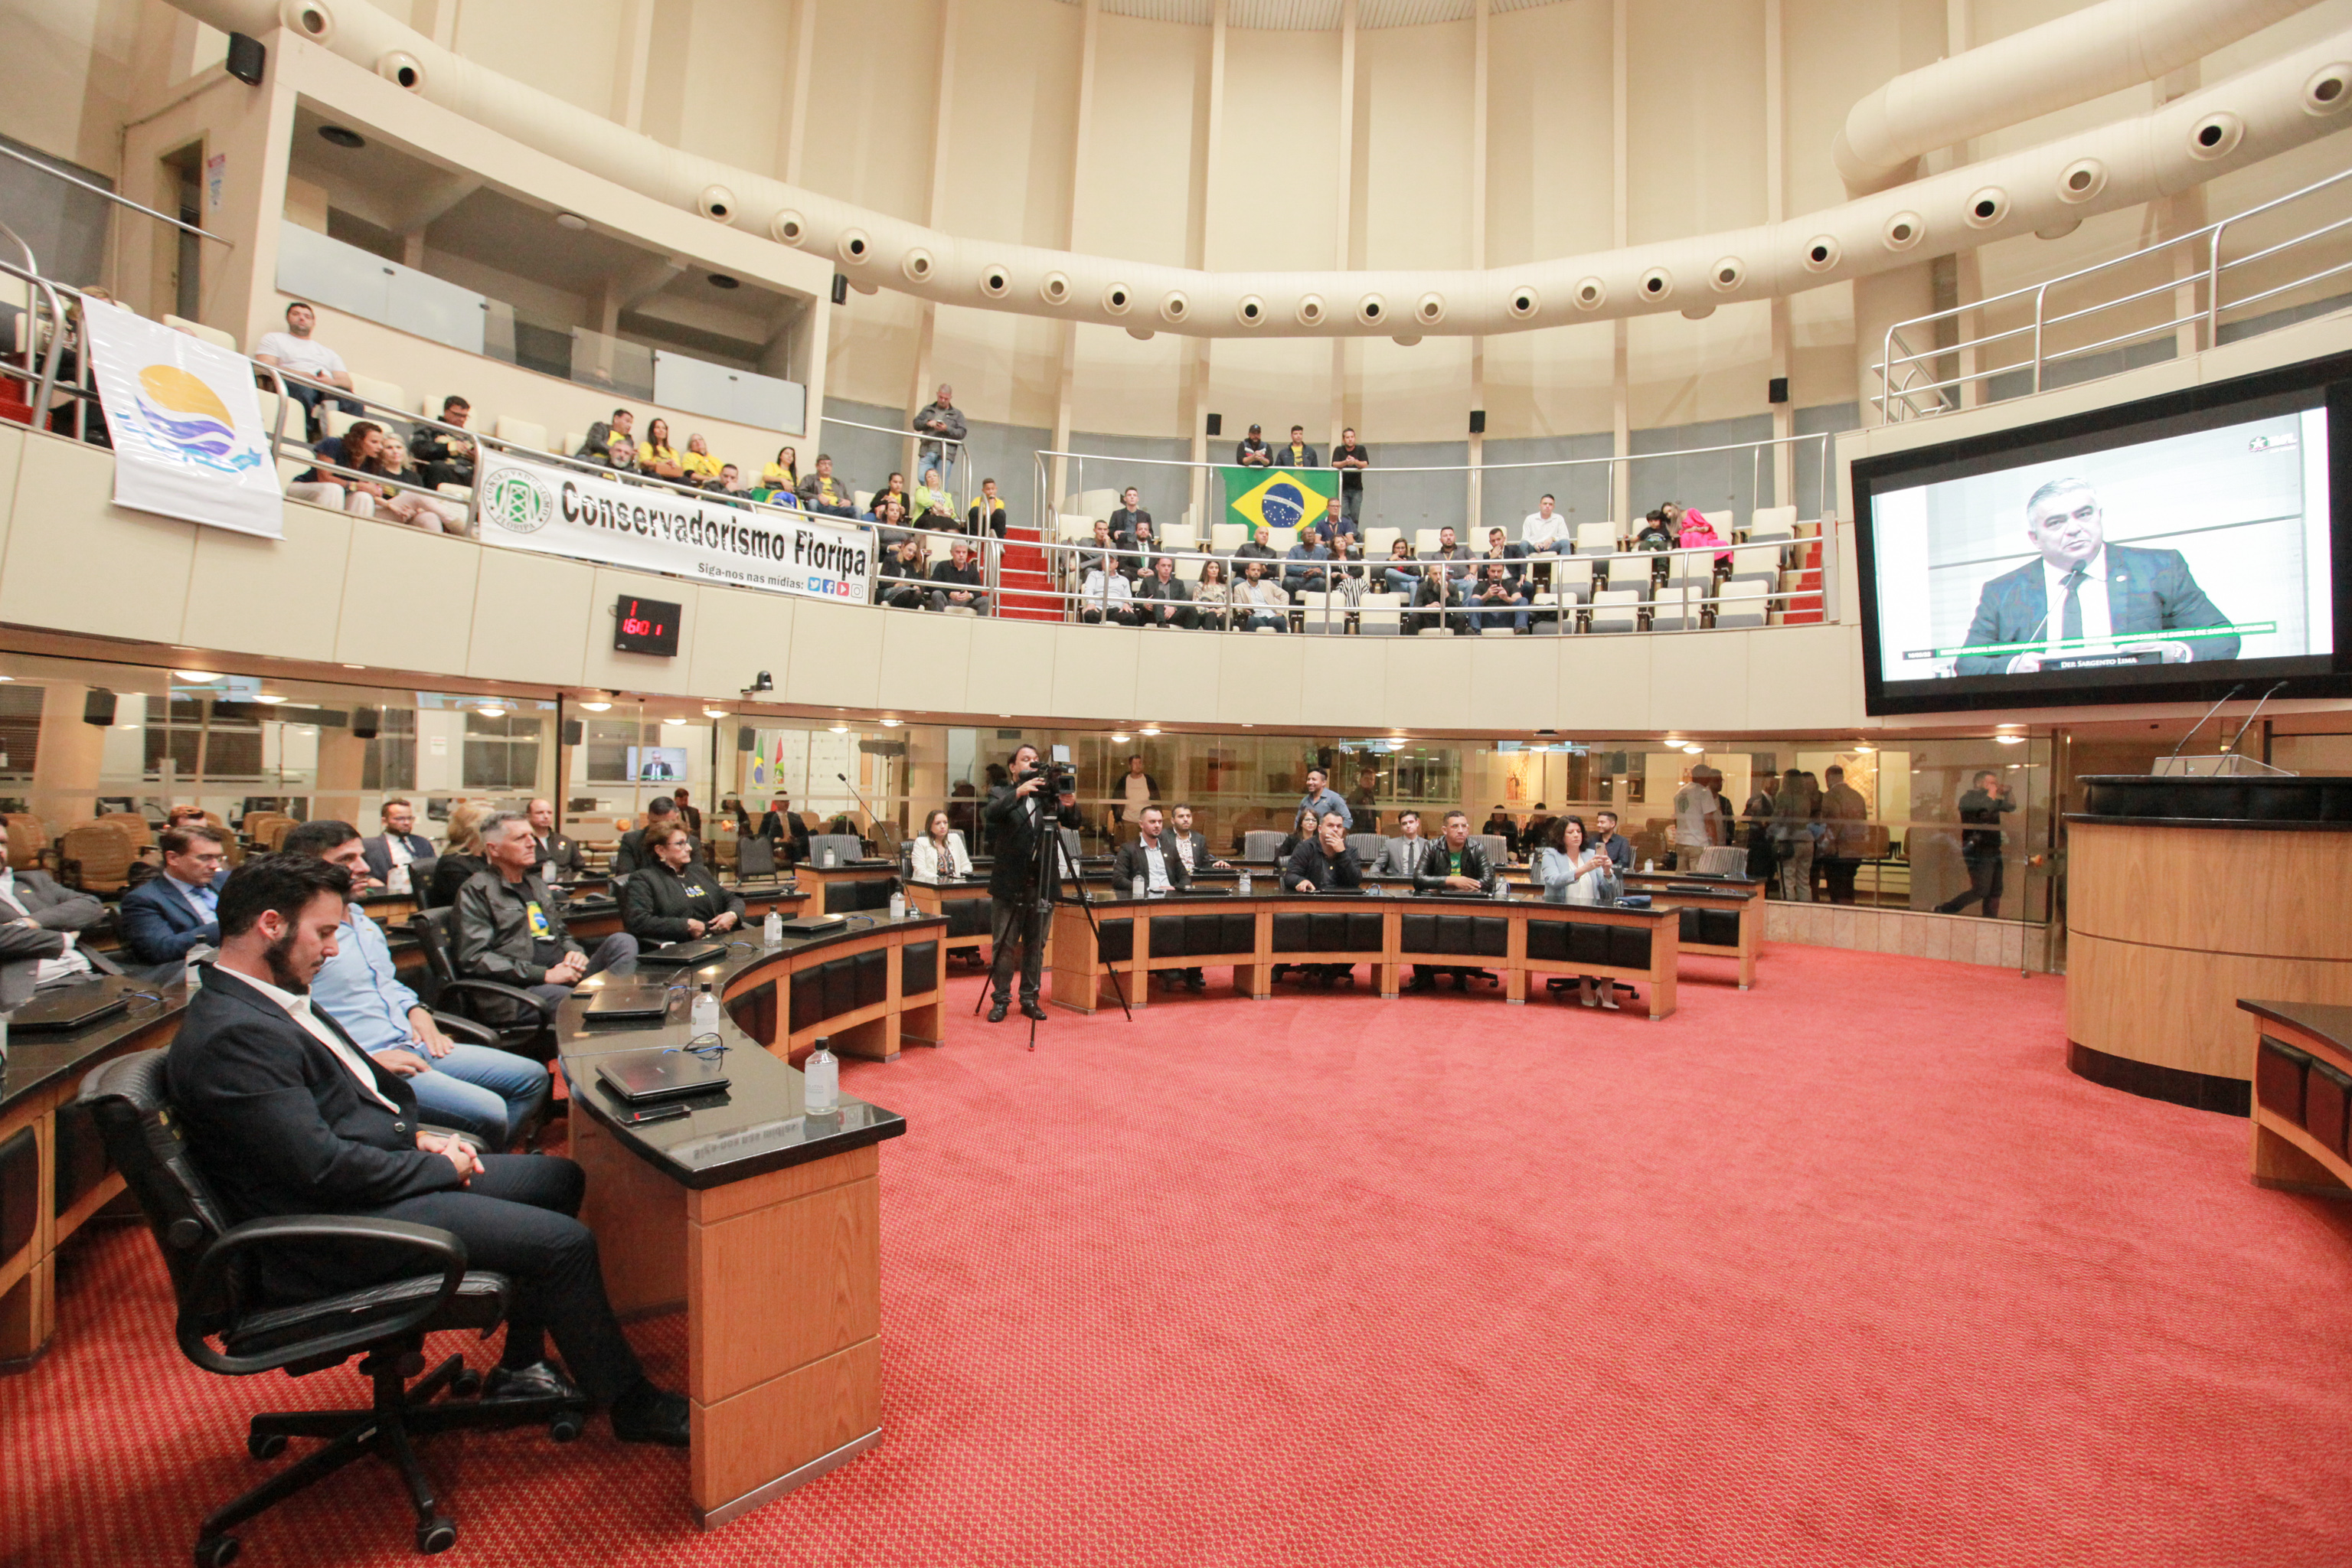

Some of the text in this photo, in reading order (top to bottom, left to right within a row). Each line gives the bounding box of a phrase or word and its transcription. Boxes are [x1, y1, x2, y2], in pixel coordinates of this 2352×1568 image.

[485, 470, 550, 515] CONSERVADORISMO
[496, 514, 536, 531] FLORIPA
[561, 481, 866, 580] Conservadorismo Floripa
[698, 563, 804, 590] Siga-nos nas mídias:
[2077, 658, 2117, 667] SARGENTO
